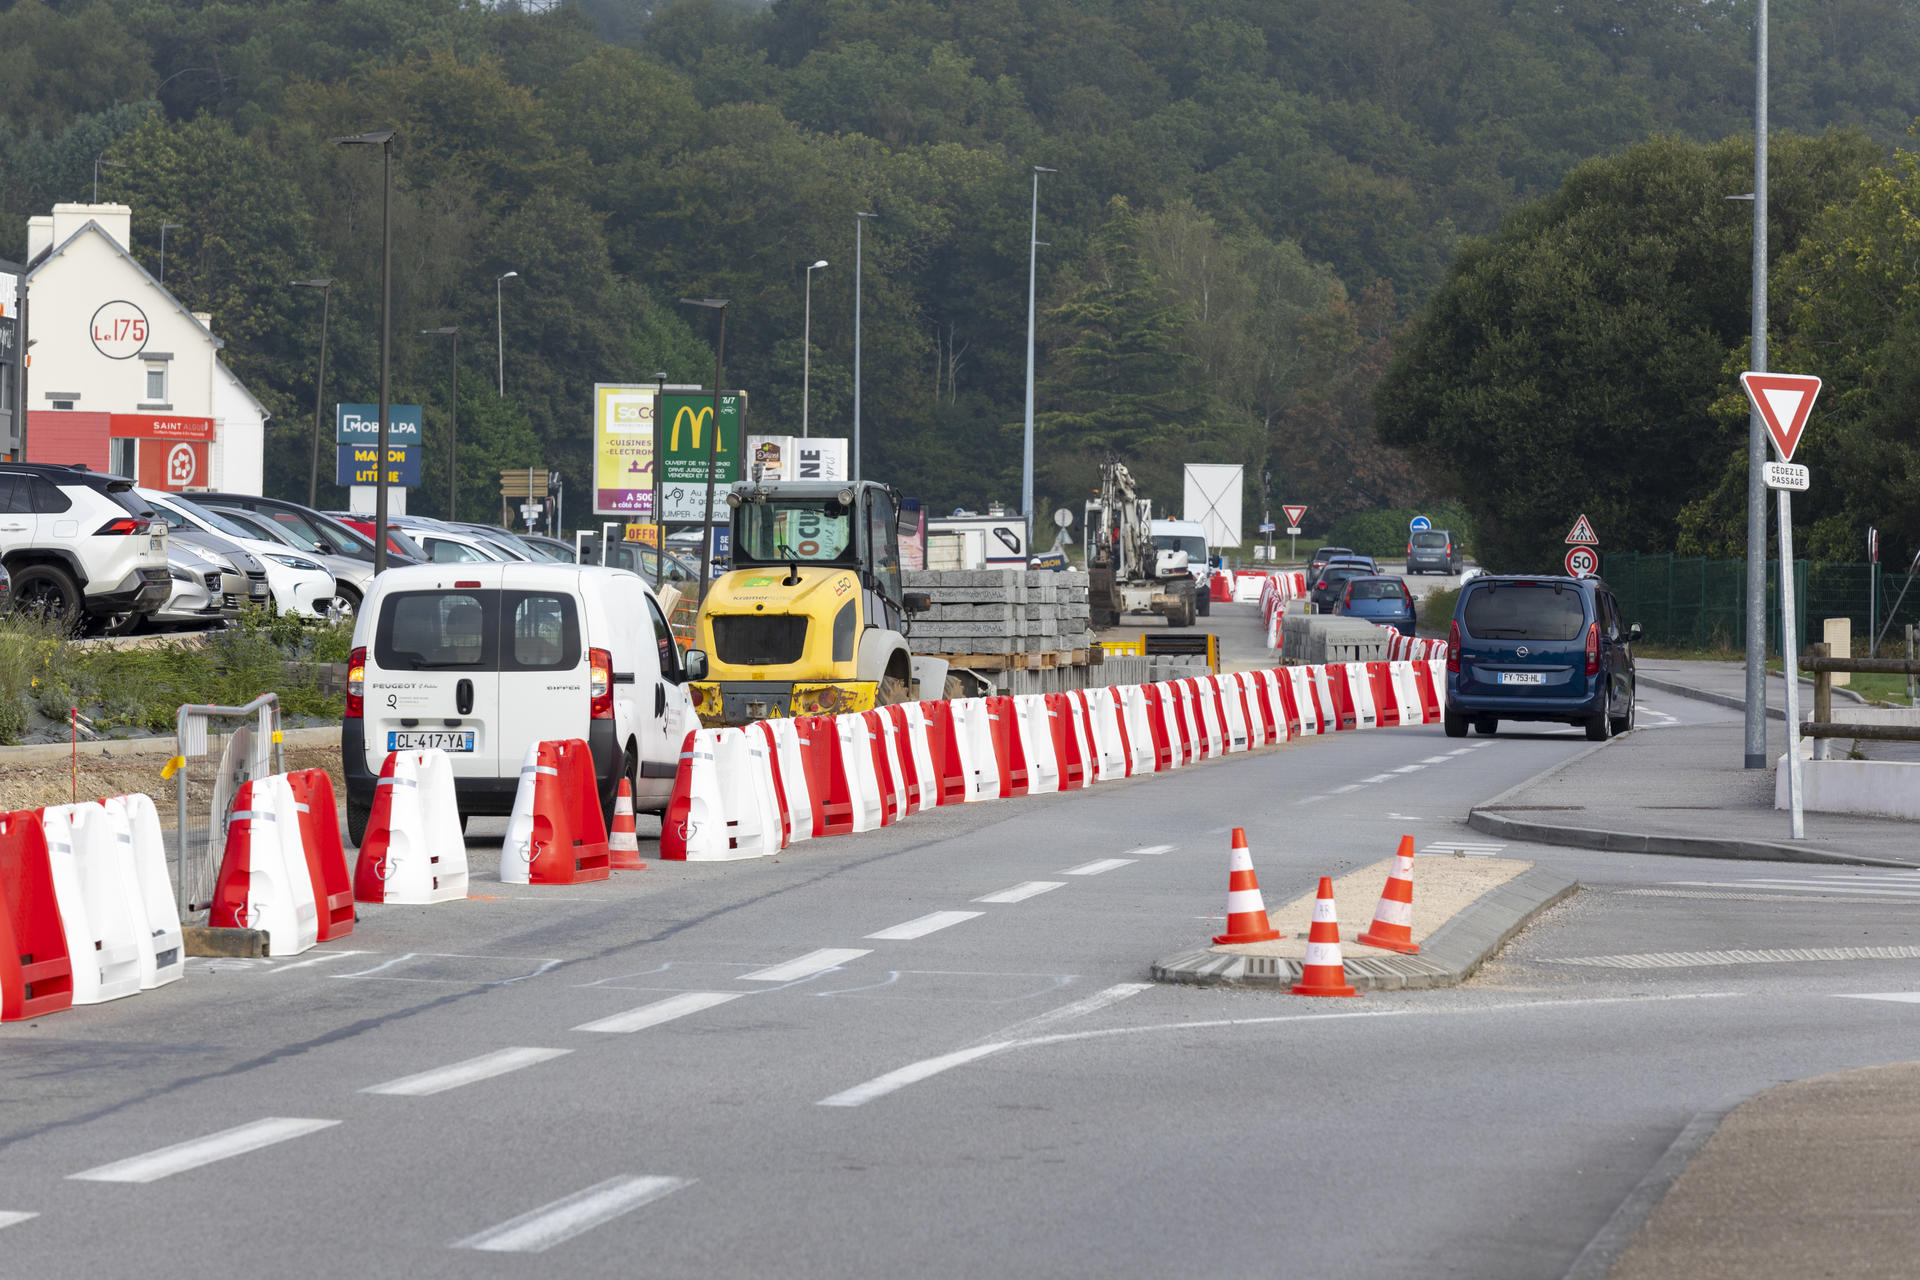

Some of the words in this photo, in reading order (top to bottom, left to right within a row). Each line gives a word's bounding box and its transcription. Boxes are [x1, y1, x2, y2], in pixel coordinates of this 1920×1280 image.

[114, 319, 145, 341] 175
[153, 421, 182, 431] SAINT
[349, 421, 417, 434] MOBLPA
[355, 450, 406, 462] MAON
[356, 471, 400, 482] LITIE
[1795, 469, 1805, 477] LE
[1771, 476, 1805, 487] PASSAGE
[628, 528, 658, 539] OFFR
[1573, 556, 1592, 569] 50
[397, 734, 464, 749] CL-417-YA
